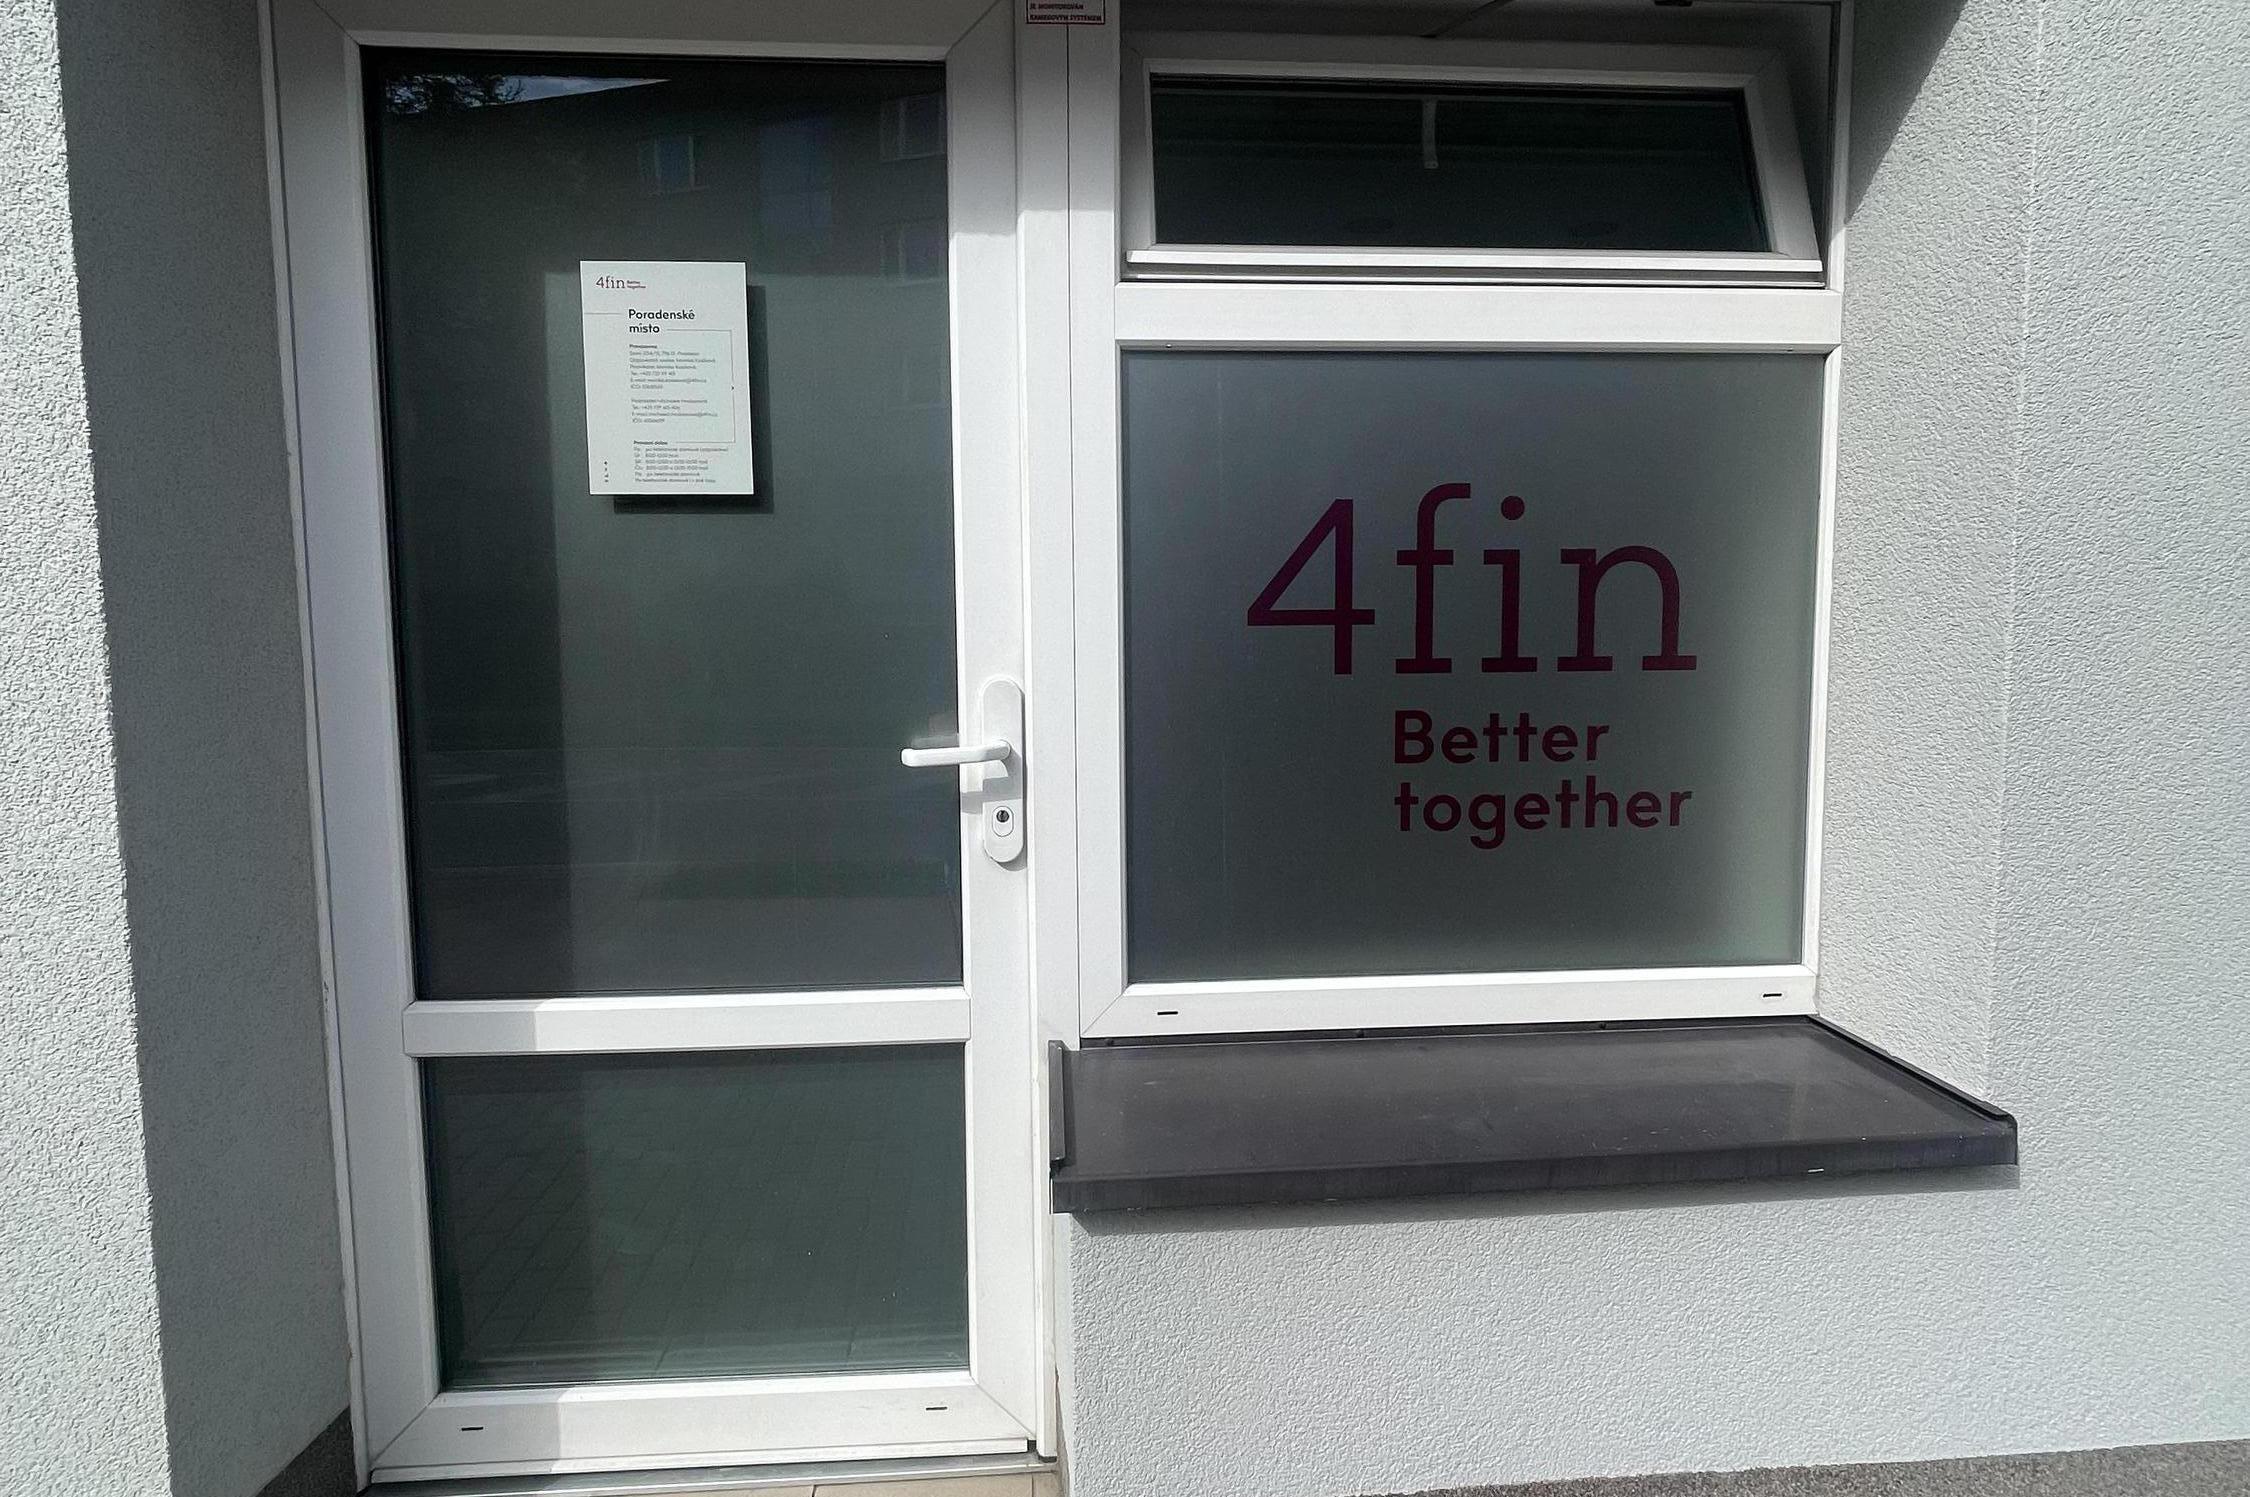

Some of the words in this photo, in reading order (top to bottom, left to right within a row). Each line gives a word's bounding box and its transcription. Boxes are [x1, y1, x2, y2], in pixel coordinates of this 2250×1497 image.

[596, 275, 626, 289] 4fin
[628, 308, 695, 320] Poradenské
[629, 322, 660, 334] místo
[1247, 482, 1698, 675] 4fin
[1394, 710, 1610, 765] Better
[1395, 776, 1693, 850] together
